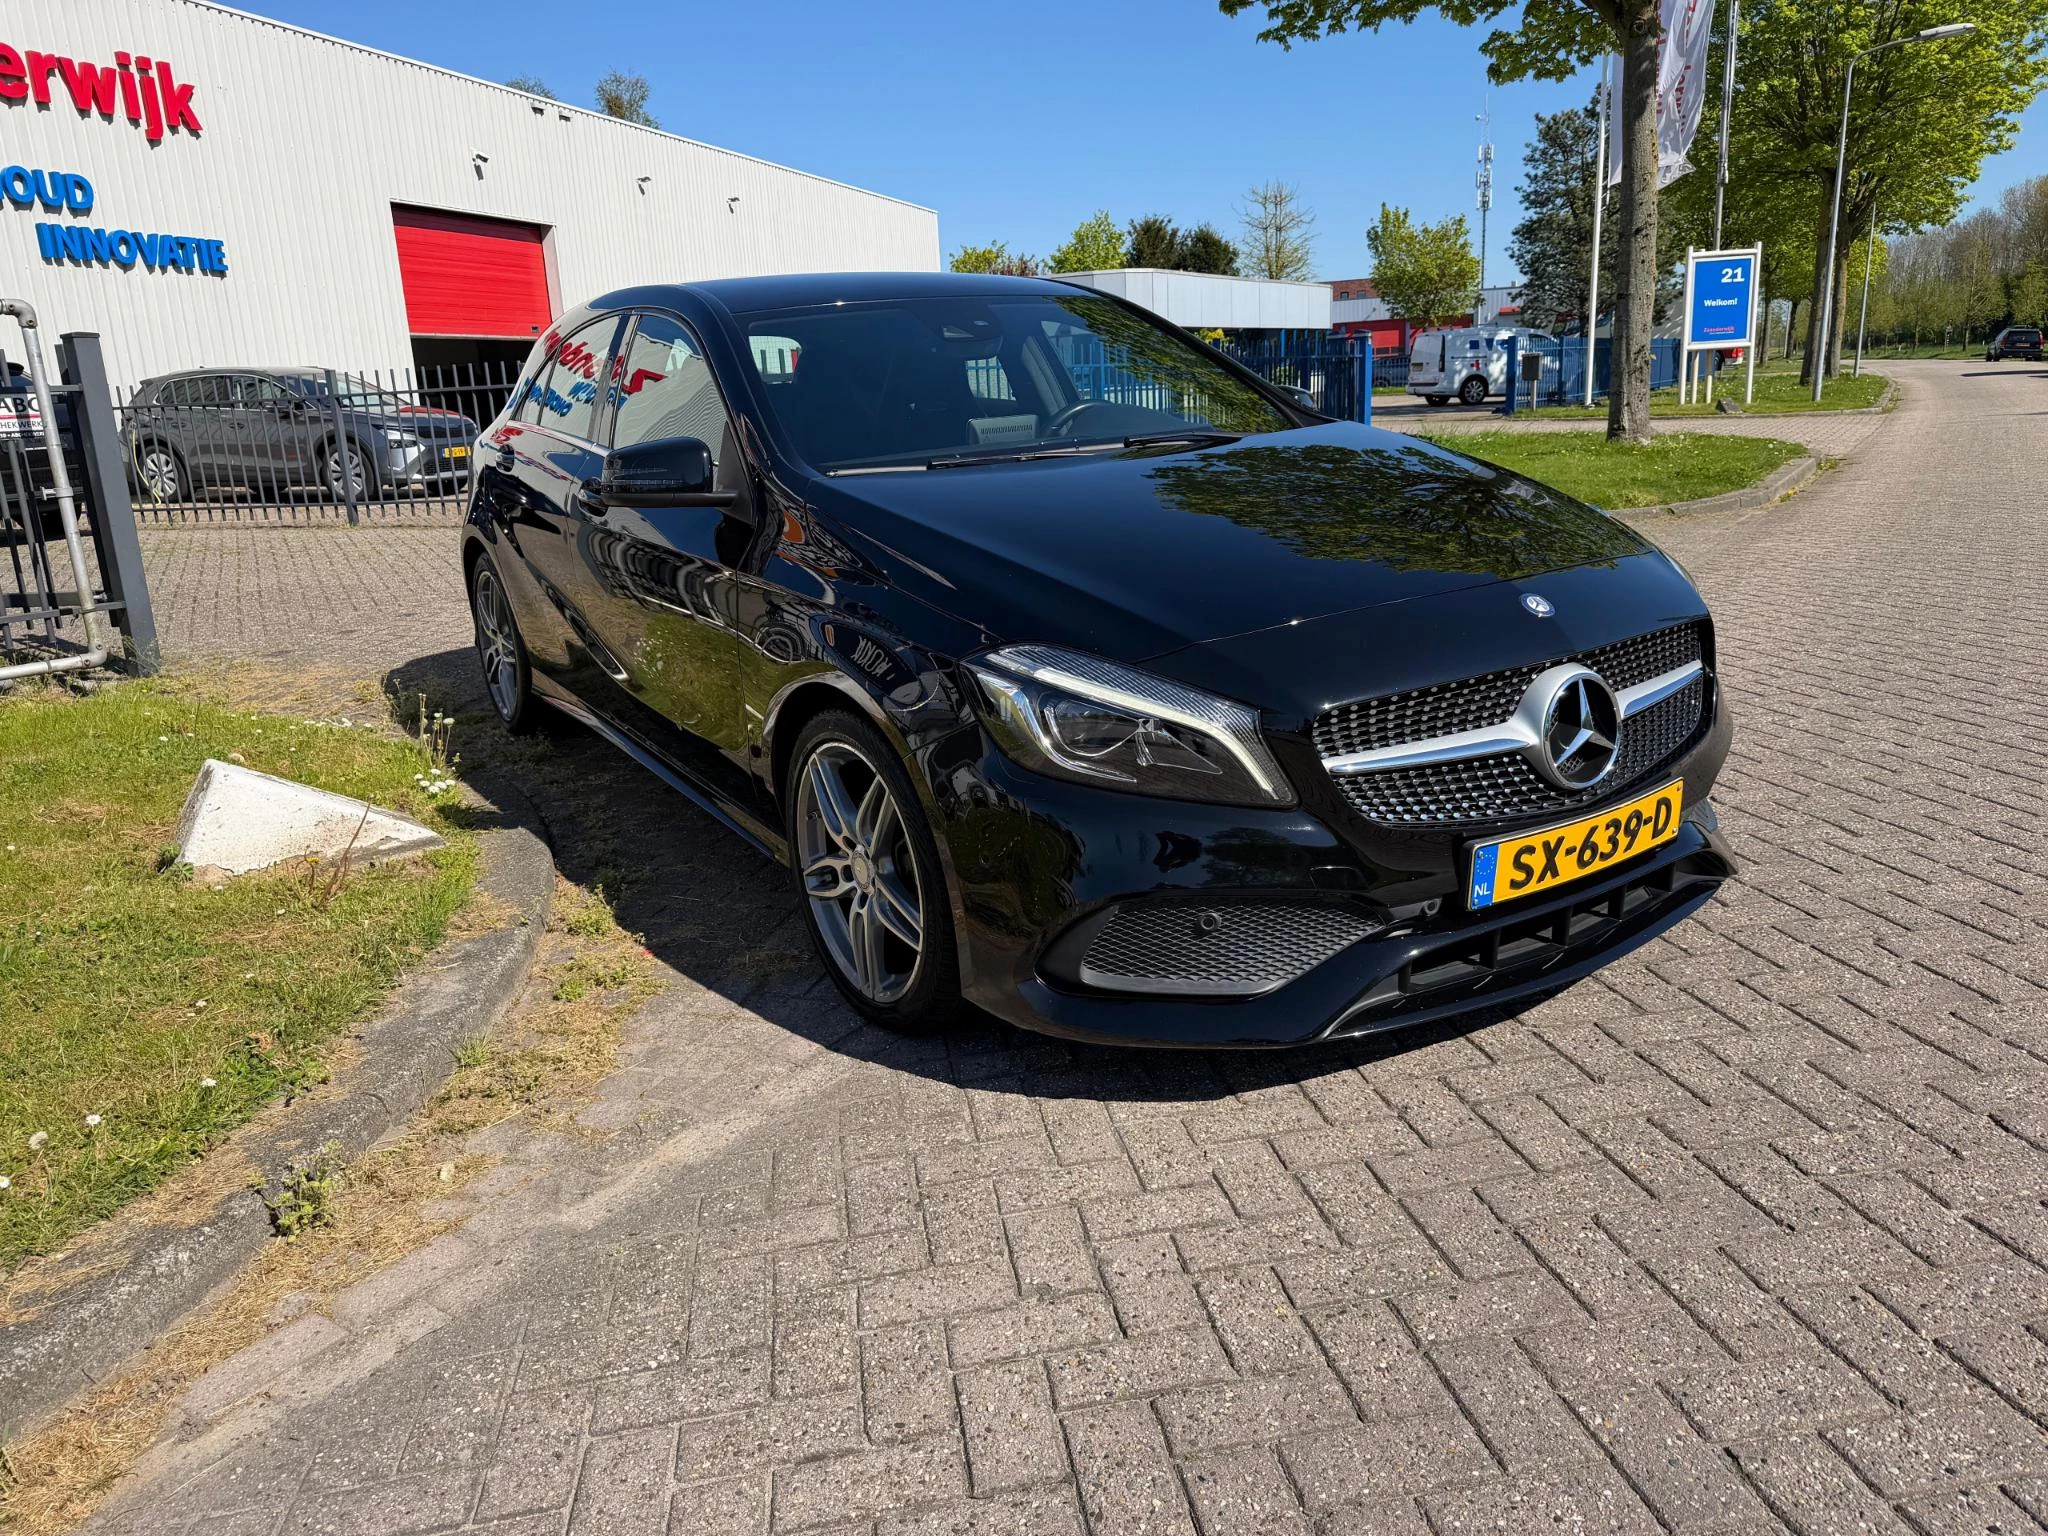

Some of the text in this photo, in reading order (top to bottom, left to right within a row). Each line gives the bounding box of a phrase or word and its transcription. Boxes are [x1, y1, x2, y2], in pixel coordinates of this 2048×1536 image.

[0, 165, 95, 209] OUD
[35, 222, 228, 271] INNOVATIE
[1720, 267, 1745, 283] 21
[1703, 298, 1738, 307] Welkom!
[1509, 796, 1673, 890] SX-639-D
[1473, 882, 1491, 898] NL
